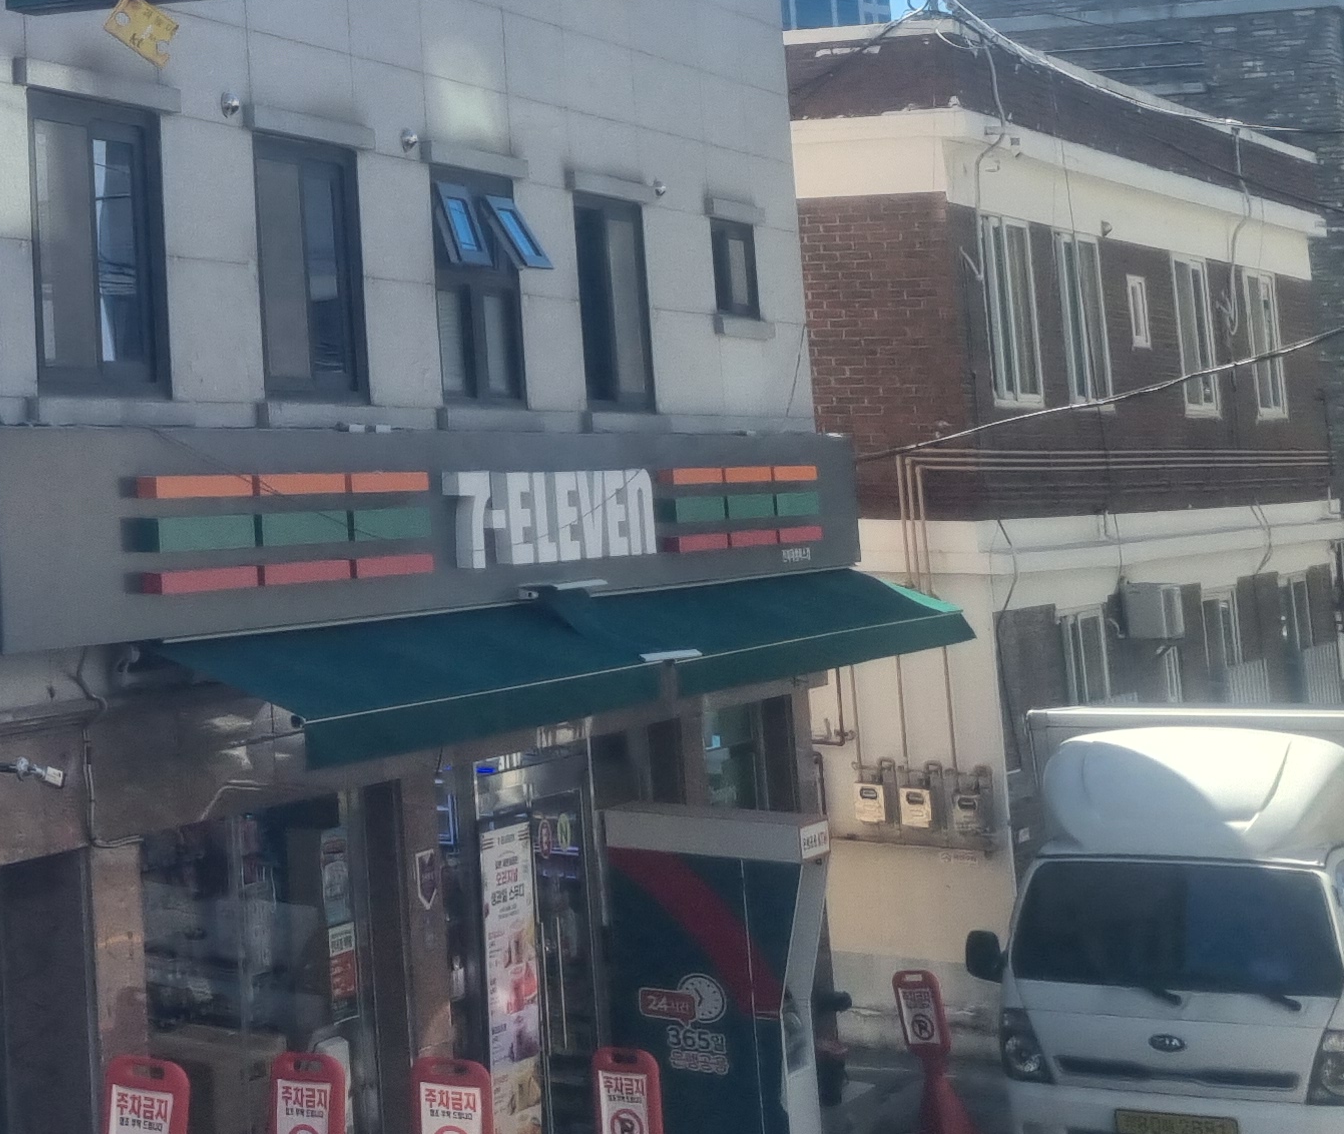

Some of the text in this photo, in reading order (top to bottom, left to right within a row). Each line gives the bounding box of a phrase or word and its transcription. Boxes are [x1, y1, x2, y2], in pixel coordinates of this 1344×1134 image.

[667, 1026, 725, 1054] 365일
[281, 1085, 327, 1110] 주차금지
[603, 1075, 645, 1096] 주차금지
[116, 1091, 168, 1124] 주차금지
[425, 1088, 476, 1112] 주차금지
